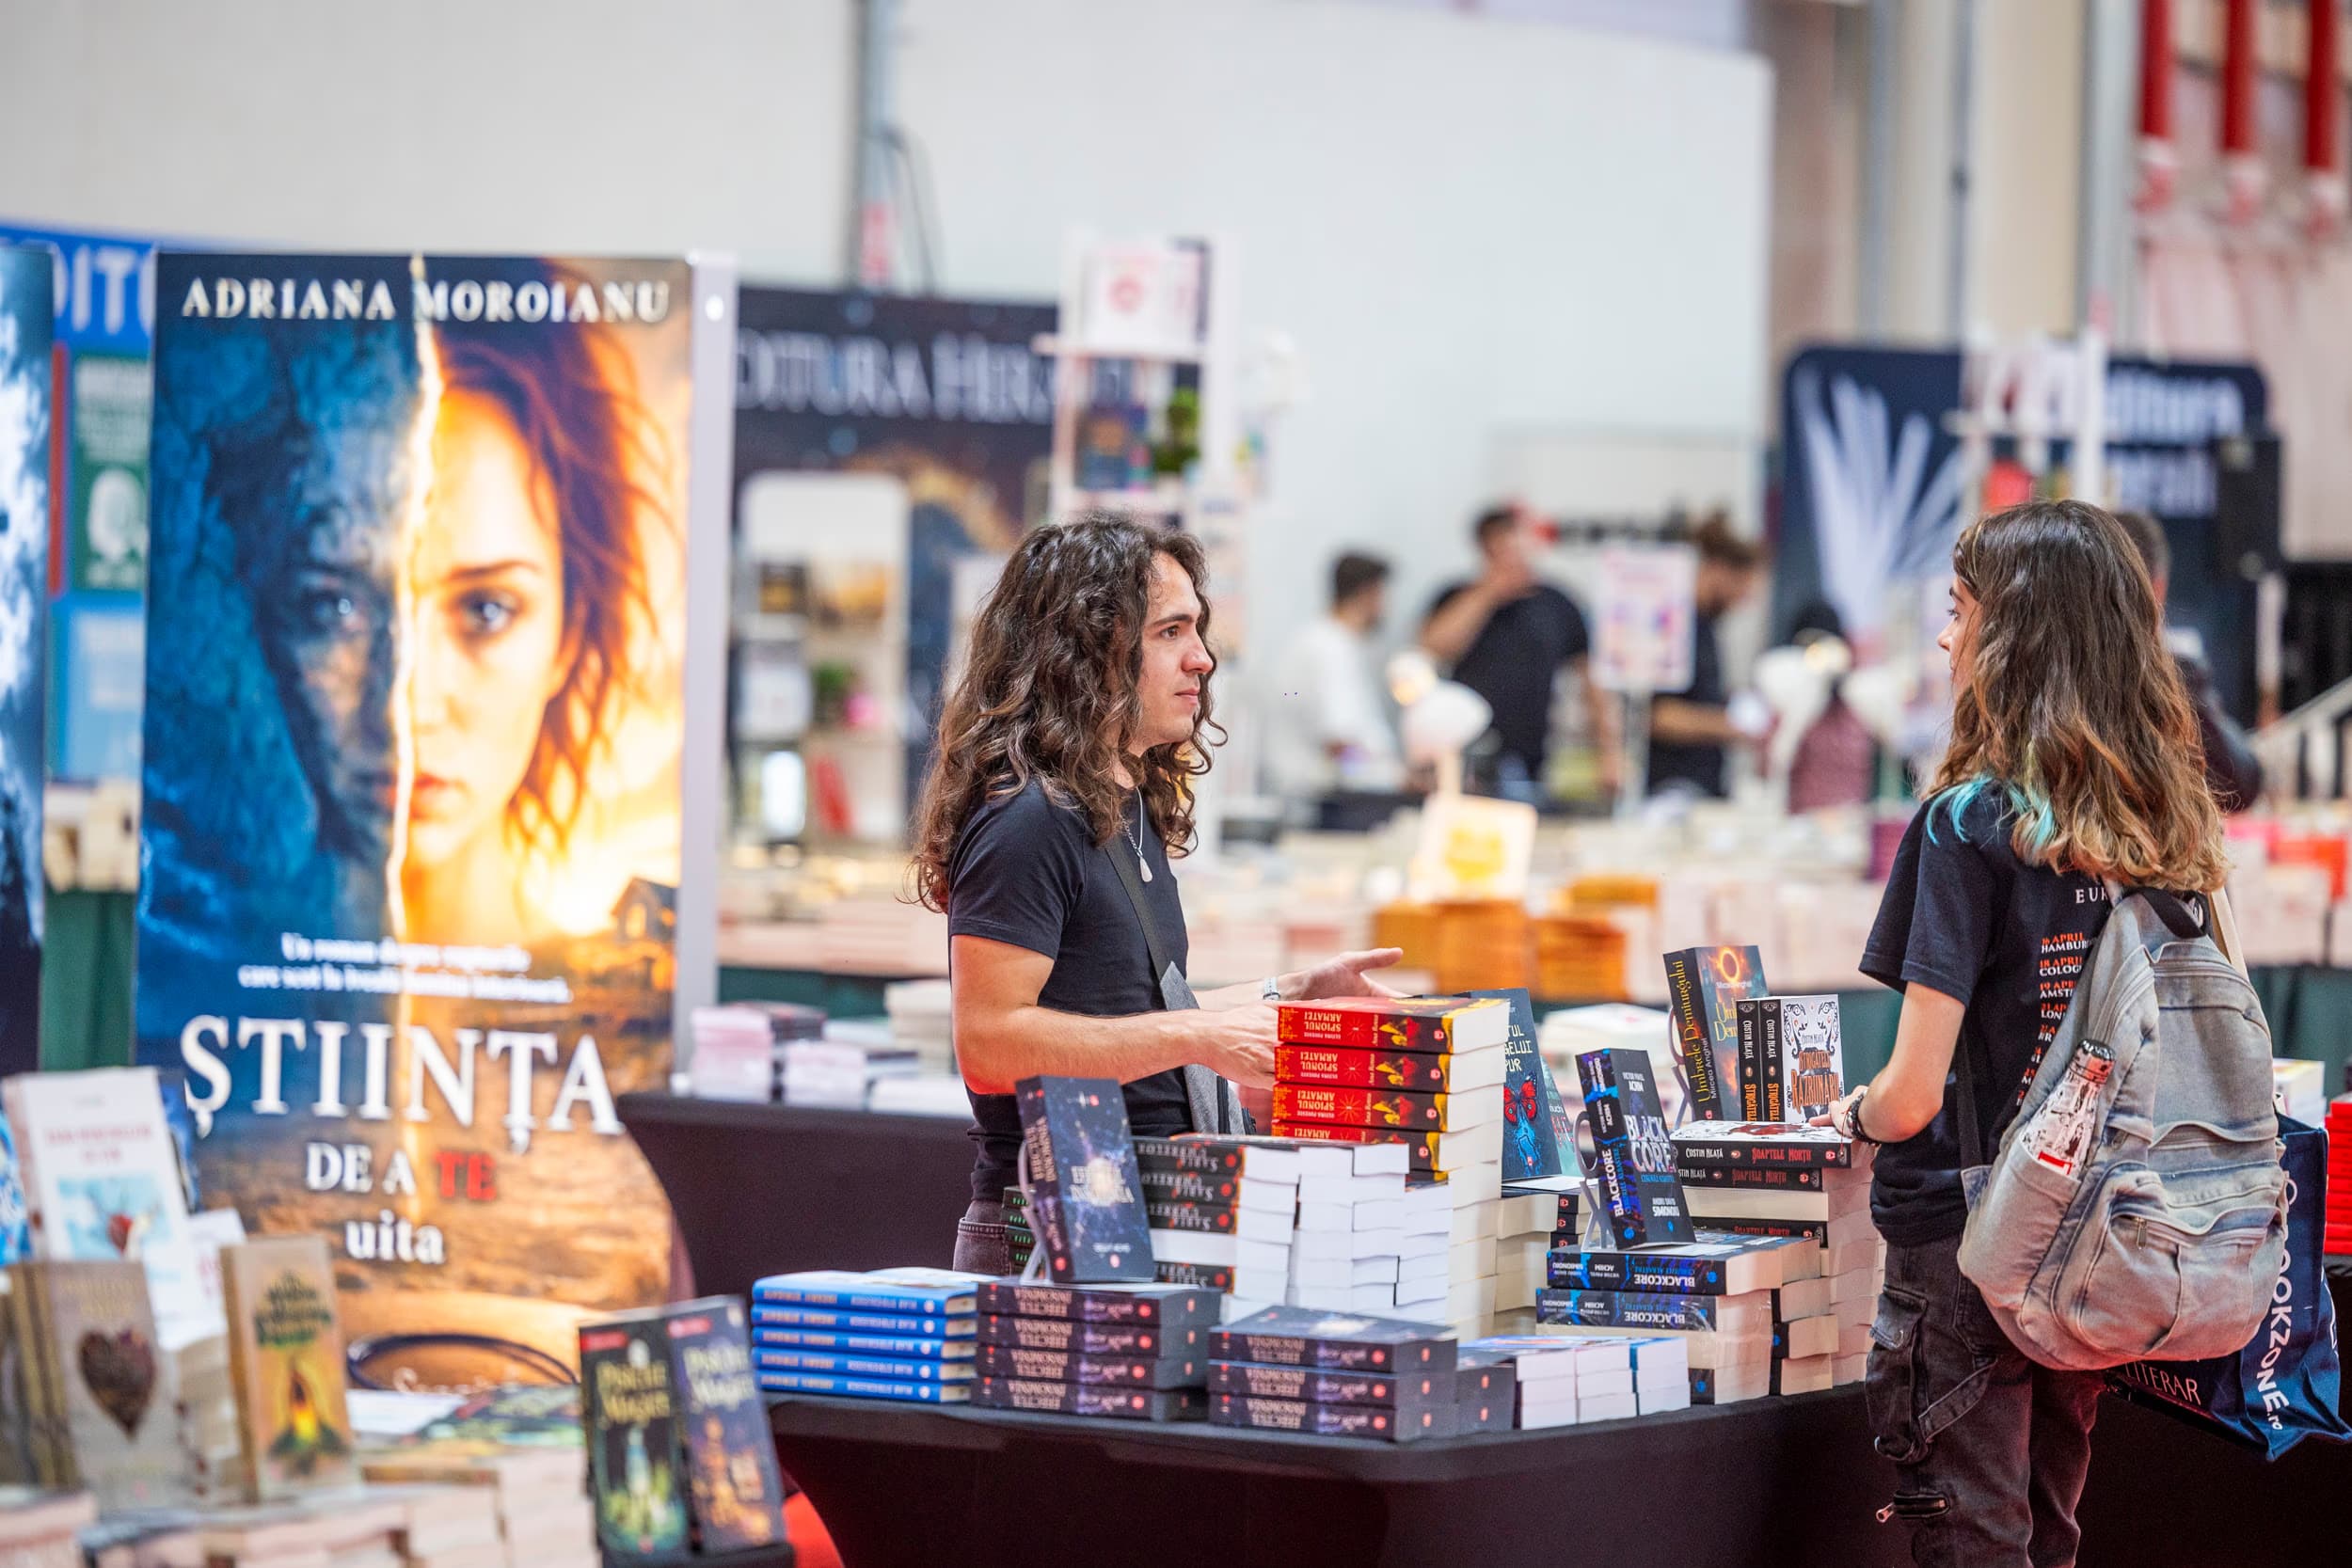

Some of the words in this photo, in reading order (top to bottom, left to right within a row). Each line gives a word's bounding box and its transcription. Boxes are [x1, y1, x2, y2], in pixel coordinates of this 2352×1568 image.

[183, 279, 395, 320] ADRIANA
[413, 281, 669, 324] MOROIANU
[2040, 964, 2081, 976] COLOG
[1670, 960, 1702, 1041] Demiurgului
[2040, 989, 2073, 999] AMST
[2054, 1003, 2068, 1011] AP
[1305, 1012, 1342, 1022] ARMATEI
[2042, 1010, 2066, 1021] LON
[1305, 1022, 1342, 1032] SPIONUL
[1507, 1023, 1525, 1037] TUL
[1742, 1020, 1753, 1040] COSTIN
[1766, 1019, 1775, 1039] COSTIN
[1505, 1040, 1533, 1054] GELUI
[1702, 1037, 1712, 1069] Anghel
[1301, 1052, 1338, 1062] ARMATEI
[1301, 1061, 1338, 1072] SPIONUL
[1686, 1044, 1709, 1103] Umbrele
[182, 1014, 626, 1155] ȘTIINȚA
[1707, 1069, 1717, 1099] Mircea
[1298, 1090, 1335, 1101] ARMATEI
[1298, 1100, 1335, 1111] SPIONUL
[1604, 1103, 1613, 1126] ACHIM
[1295, 1128, 1330, 1139] ARMATEI
[1623, 1115, 1668, 1142] BLACK
[1631, 1141, 1676, 1173] CORE
[1686, 1148, 1705, 1158] COSTIN
[306, 1141, 373, 1193] DE
[382, 1150, 416, 1196] A
[435, 1150, 496, 1200] TE
[1678, 1167, 1691, 1178] STIN
[1140, 1173, 1201, 1189] UMBRELO
[1602, 1148, 1623, 1216] BLACKCORE
[344, 1210, 446, 1264] uita
[1595, 1263, 1614, 1272] ACHIM
[1634, 1274, 1695, 1288] BLACKCORE
[1624, 1311, 1685, 1324] BLACKCORE
